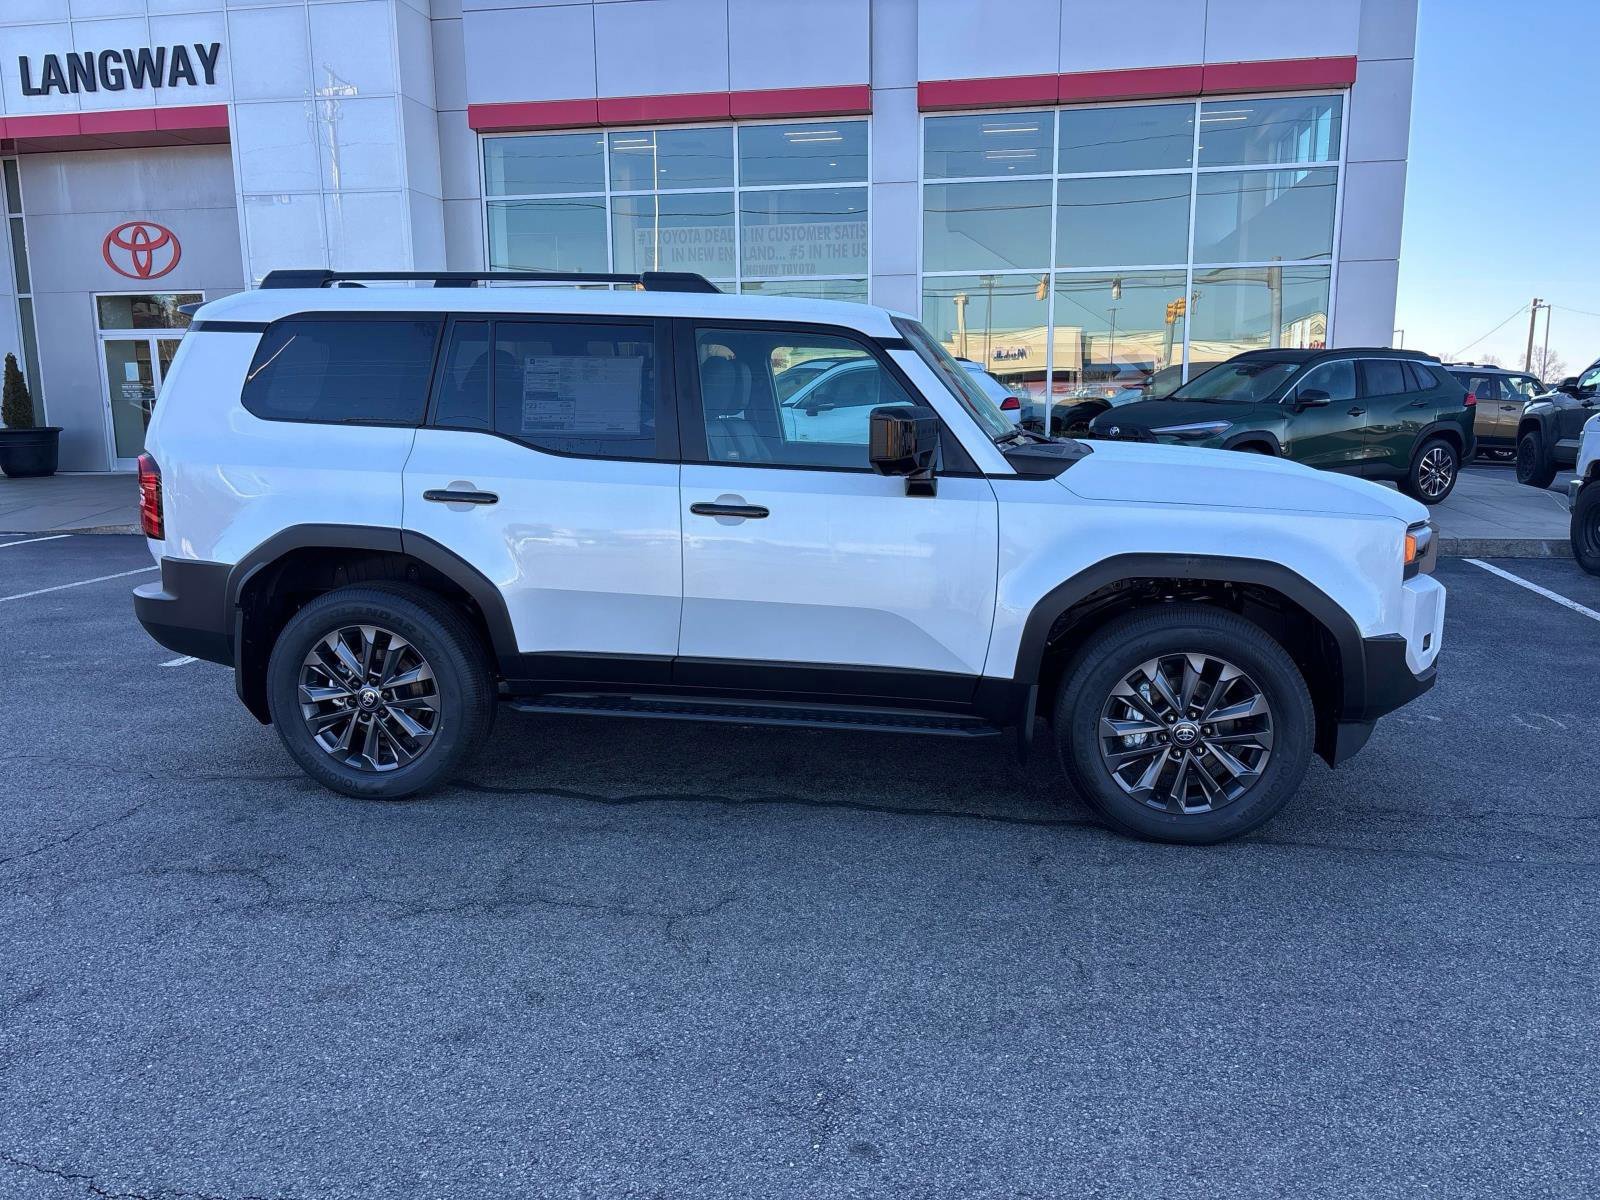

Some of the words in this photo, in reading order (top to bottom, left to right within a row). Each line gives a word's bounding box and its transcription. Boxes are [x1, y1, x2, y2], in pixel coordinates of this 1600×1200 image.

[18, 42, 221, 96] LANGWAY
[656, 229, 703, 245] TOYOTA
[750, 227, 764, 242] IN
[767, 224, 831, 242] CUSTOMER
[671, 247, 685, 263] IN
[687, 246, 714, 262] NEW
[788, 245, 804, 260] #5
[808, 244, 822, 259] IN
[824, 243, 848, 258] THE
[781, 263, 816, 275] TOYOTA
[298, 746, 360, 793] YOKOHAMA
